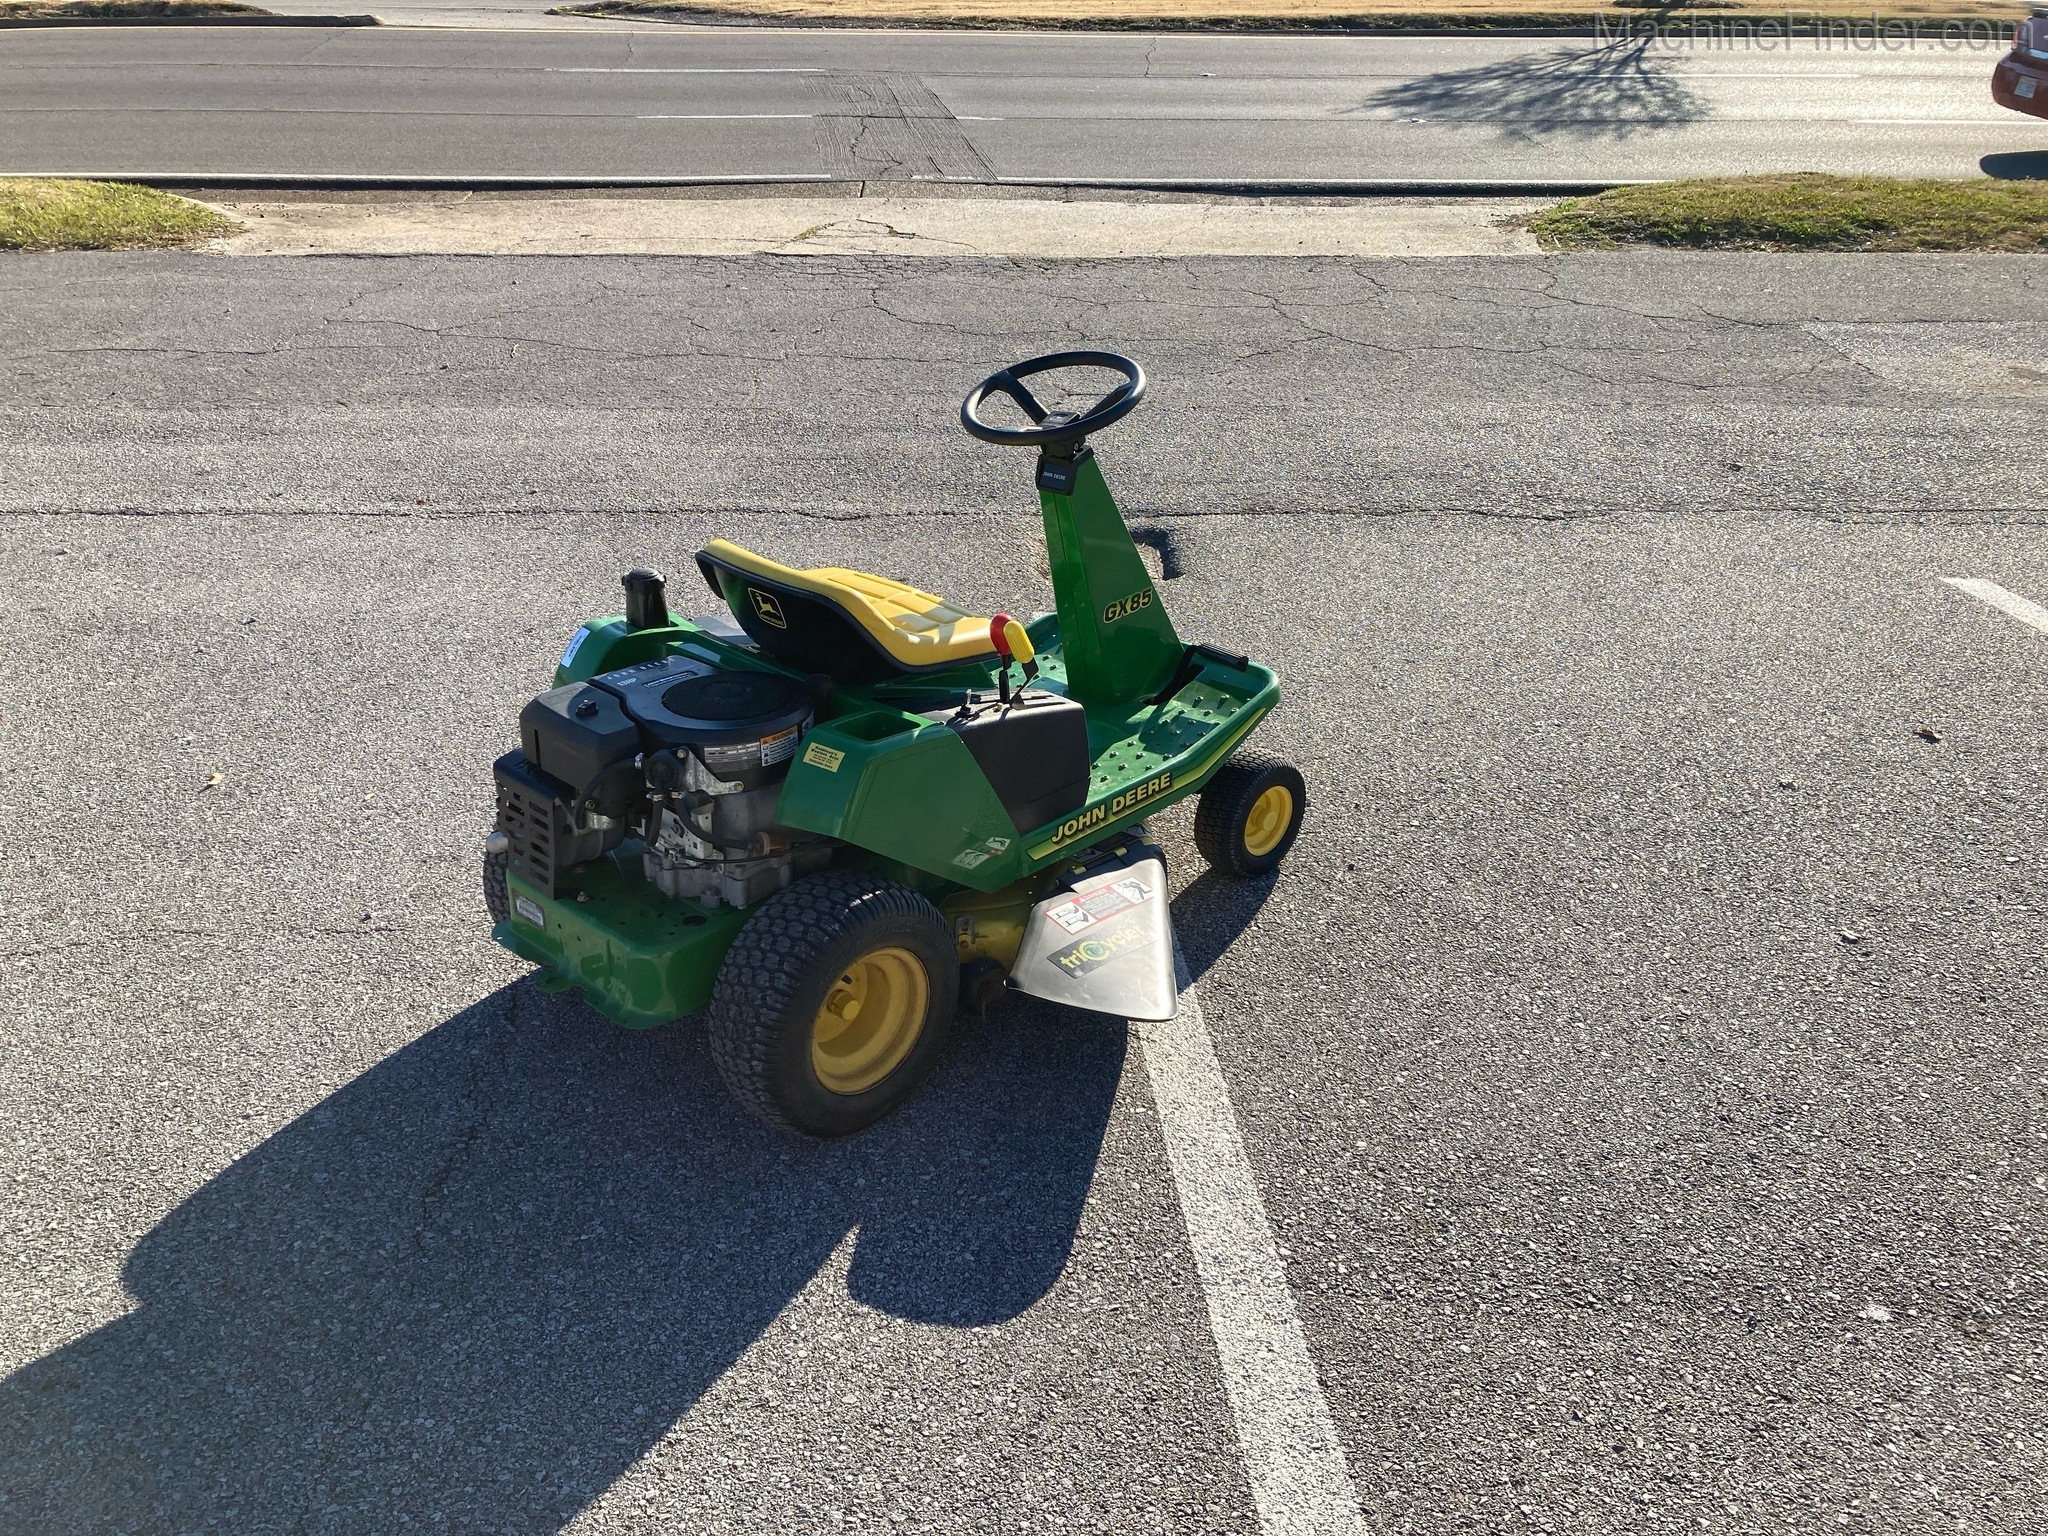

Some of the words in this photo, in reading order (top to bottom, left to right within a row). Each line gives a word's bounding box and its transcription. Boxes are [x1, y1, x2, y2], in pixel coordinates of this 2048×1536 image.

[1103, 586, 1153, 624] GX85
[1051, 804, 1108, 844] JOHN
[1111, 772, 1173, 815] DEERE
